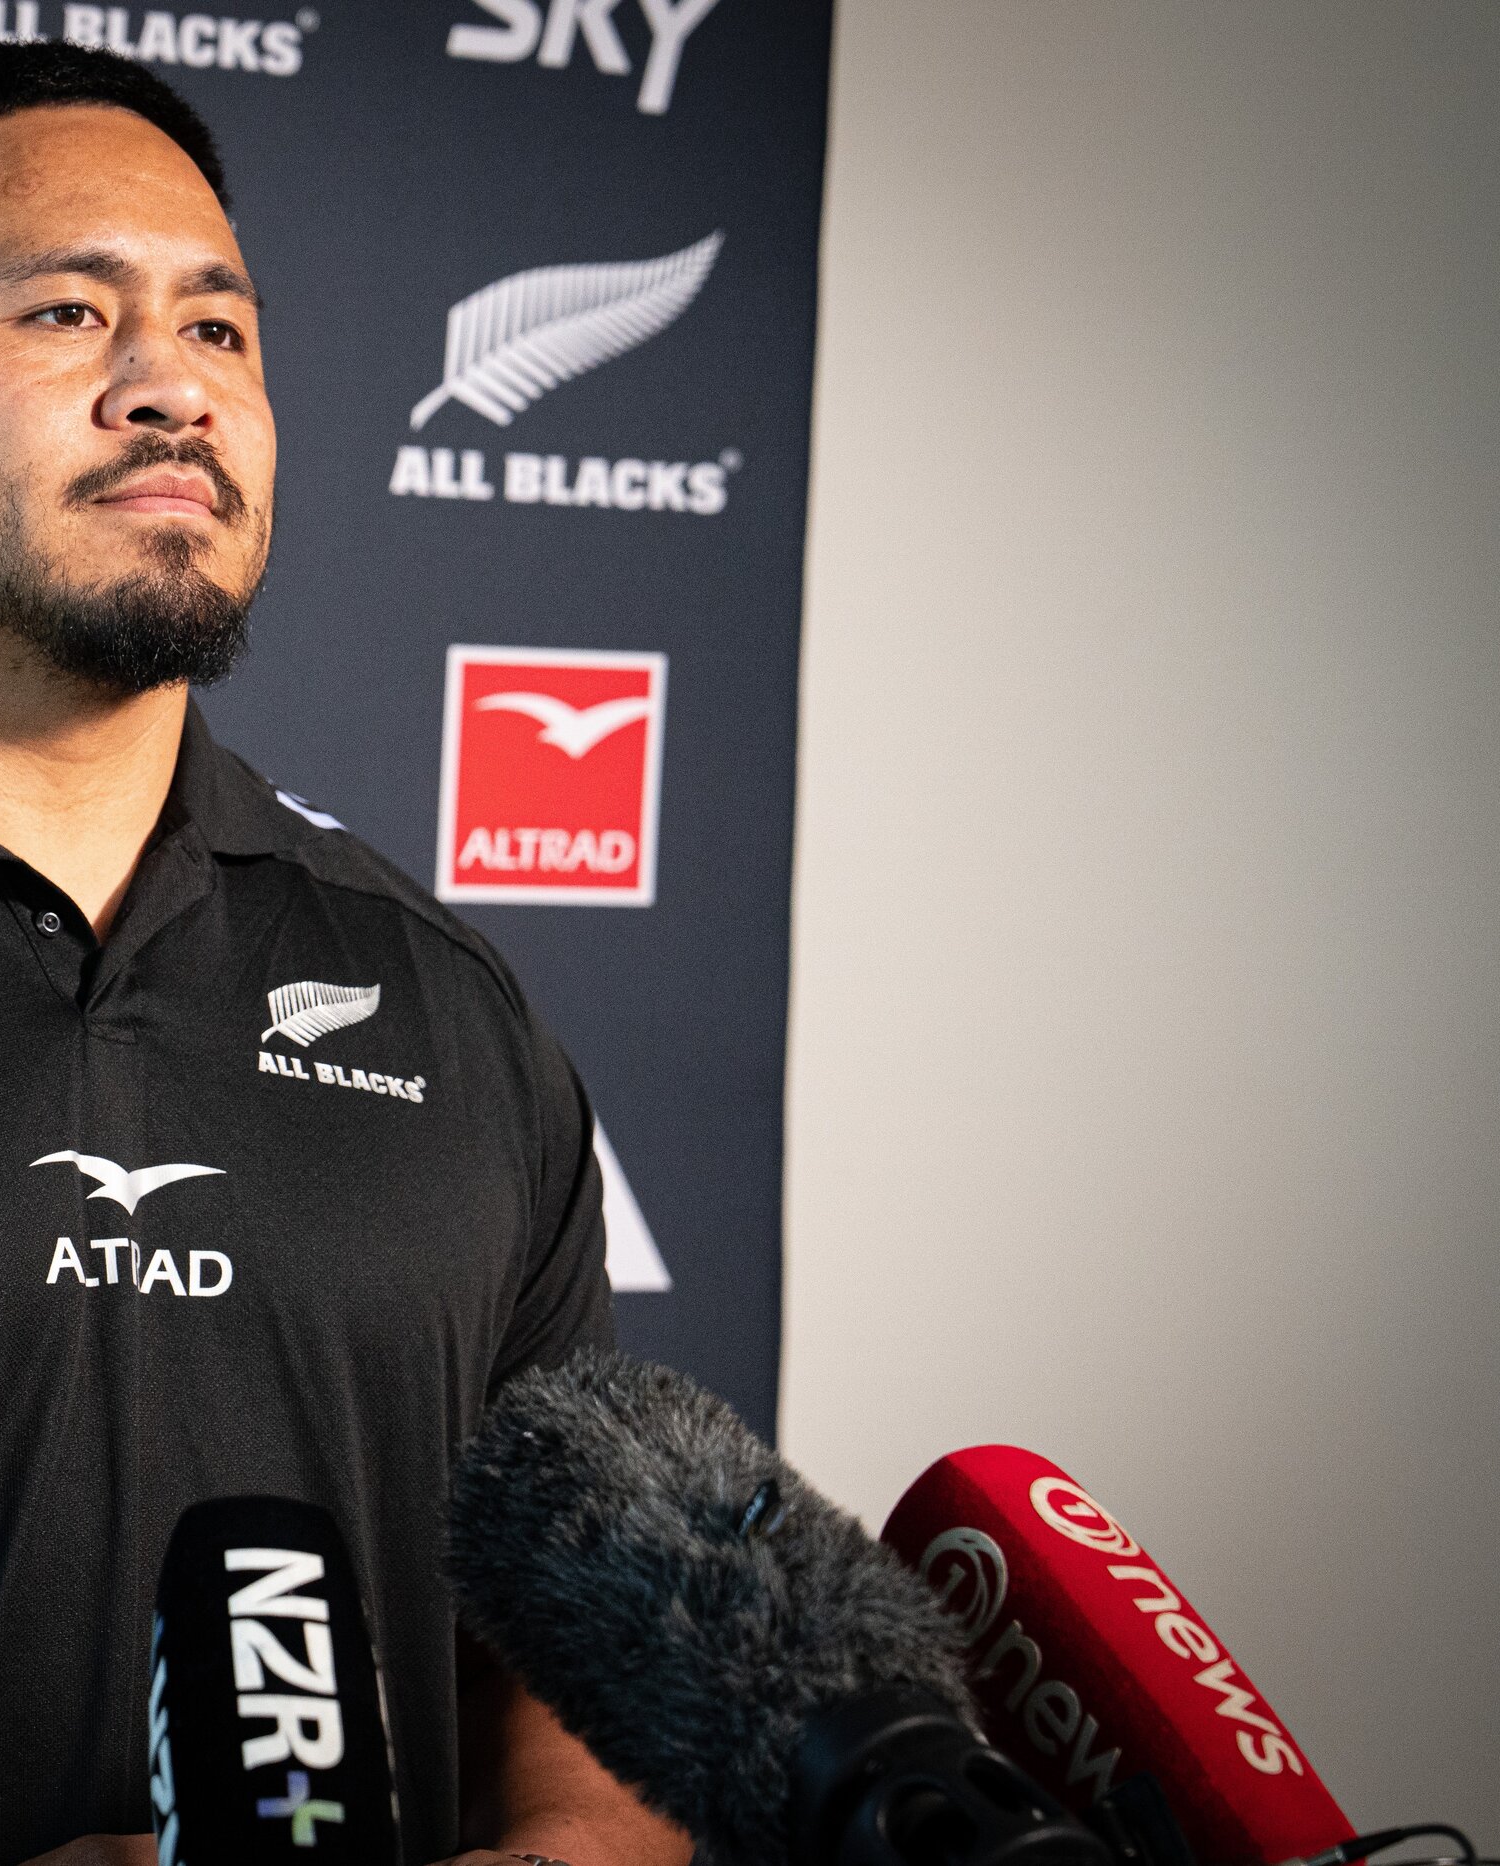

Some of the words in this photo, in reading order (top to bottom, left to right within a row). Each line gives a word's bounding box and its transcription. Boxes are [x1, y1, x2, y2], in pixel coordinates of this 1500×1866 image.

[62, 2, 303, 76] BLACKS
[388, 445, 494, 501] ALL
[503, 451, 728, 516] BLACKS
[457, 826, 636, 874] ALTRAD
[258, 1051, 310, 1080] ALL
[1106, 1564, 1304, 1777] news
